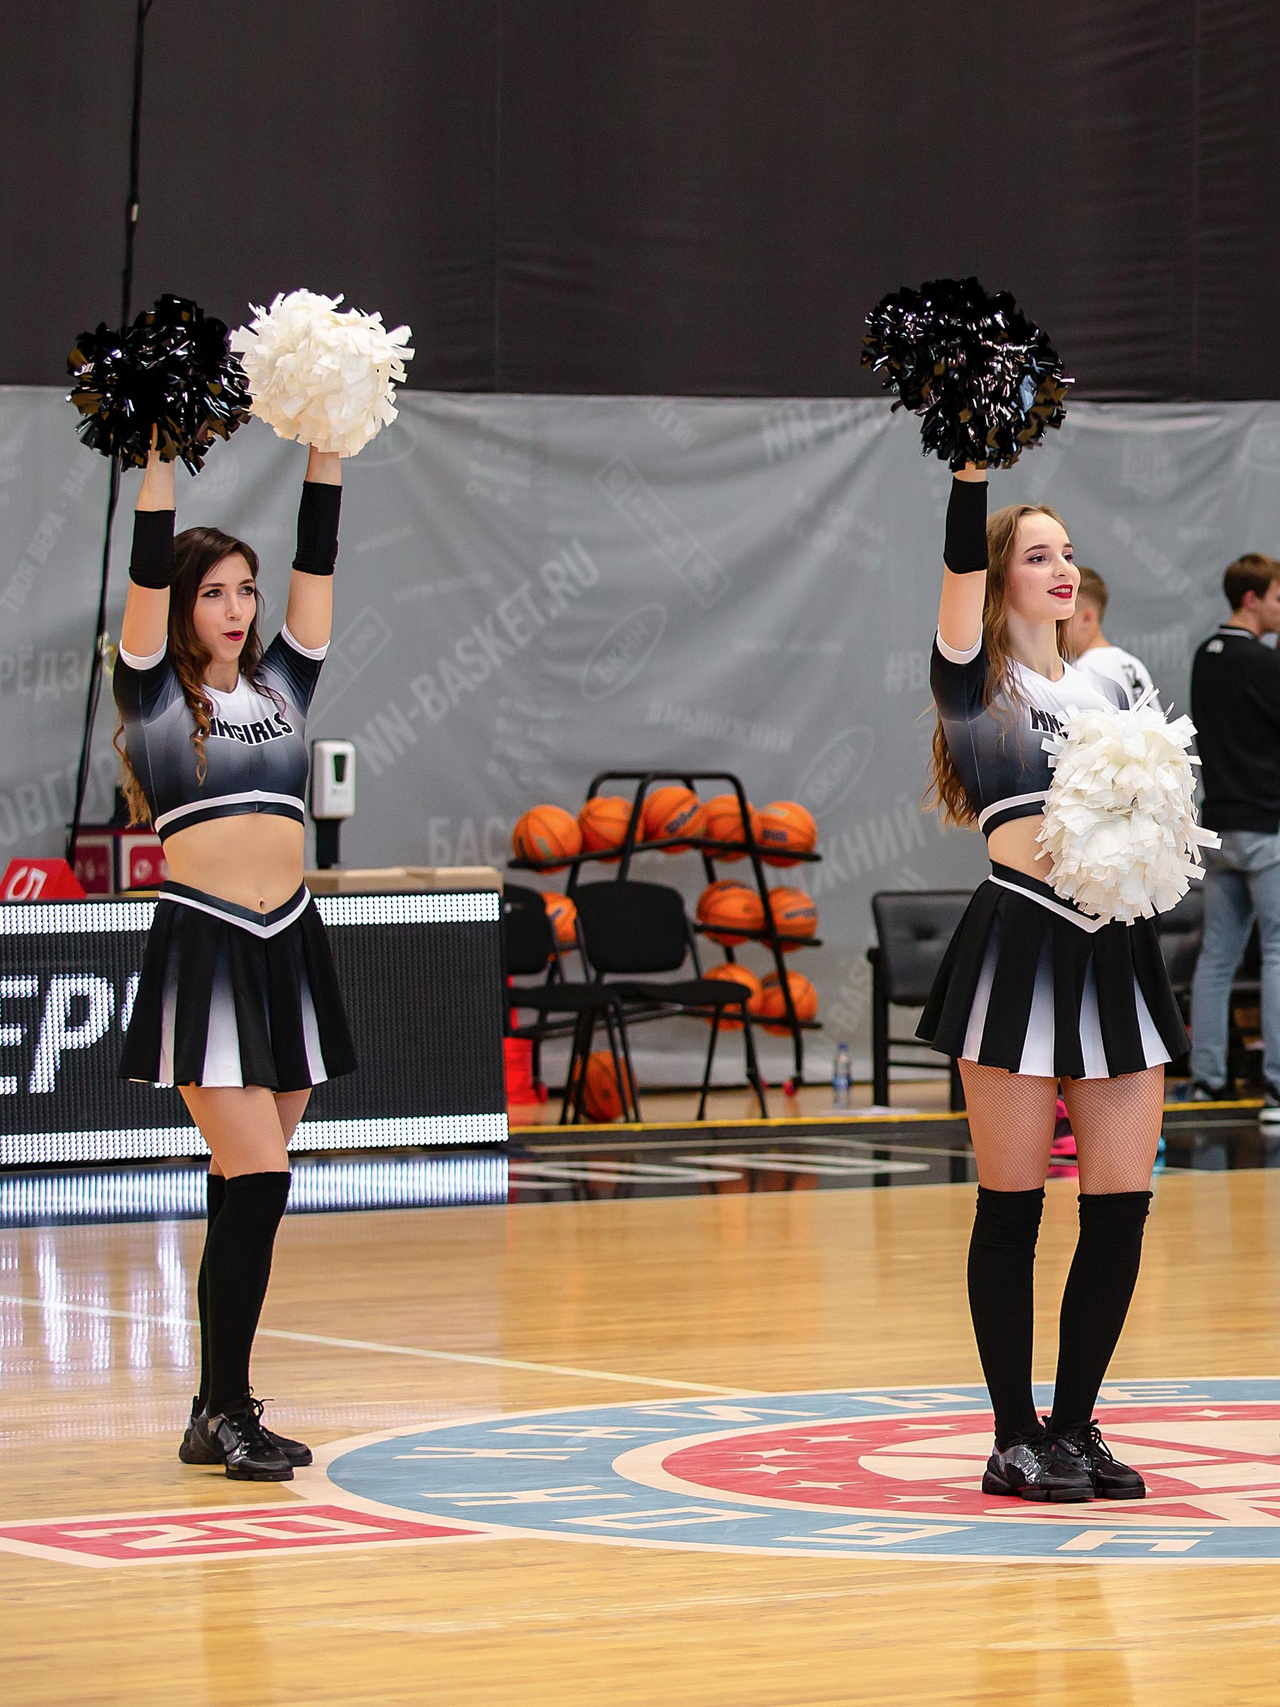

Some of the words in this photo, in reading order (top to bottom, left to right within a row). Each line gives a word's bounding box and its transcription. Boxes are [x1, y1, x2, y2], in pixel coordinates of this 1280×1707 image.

[353, 538, 600, 777] NN-BASKET.RU
[0, 972, 142, 1093] ЕР
[60, 1514, 397, 1550] 20
